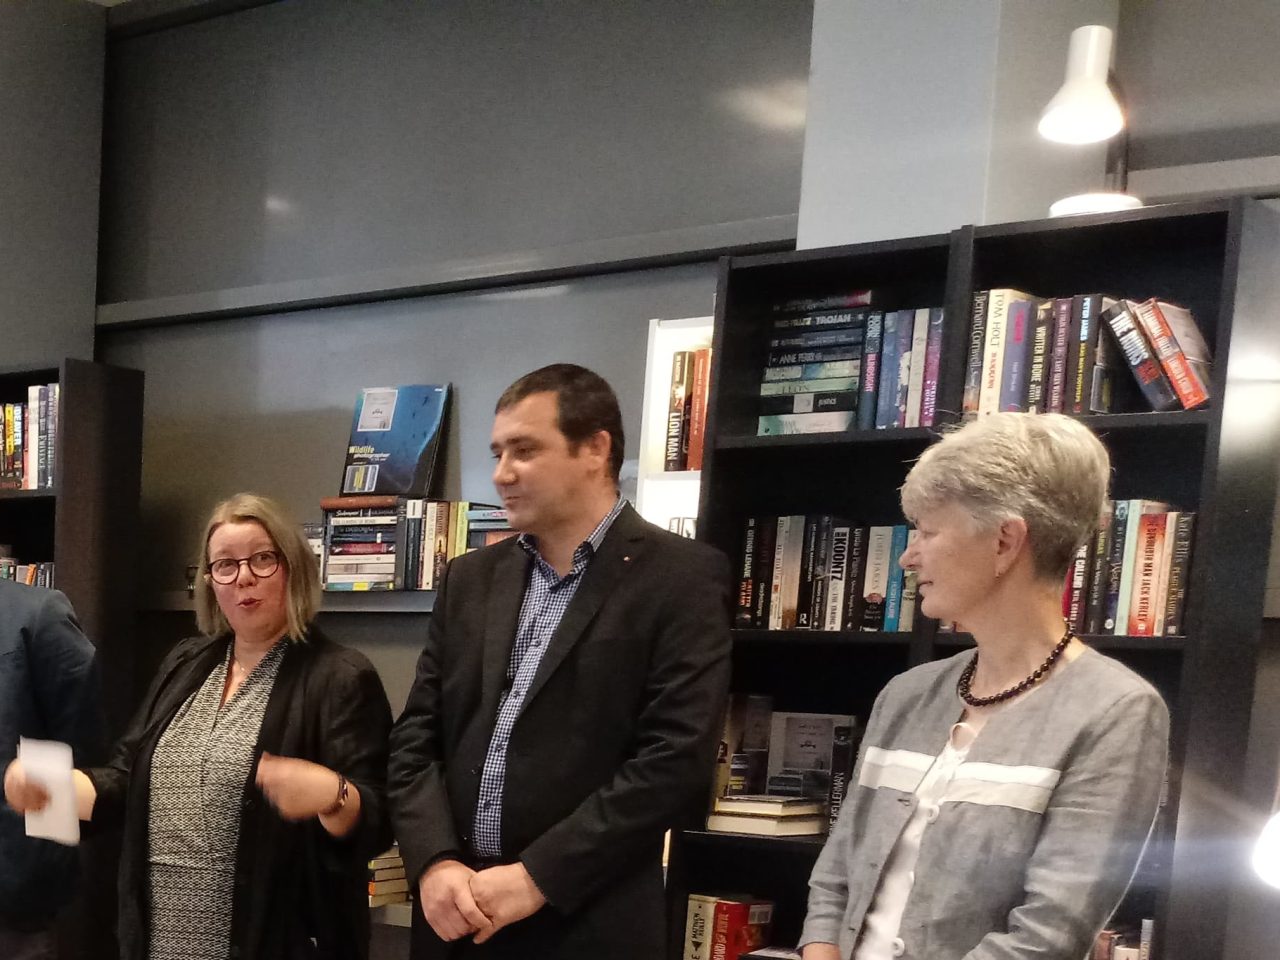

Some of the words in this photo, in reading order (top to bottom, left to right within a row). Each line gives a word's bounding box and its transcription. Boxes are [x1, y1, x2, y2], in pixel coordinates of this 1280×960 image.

[973, 296, 987, 330] Bernard
[993, 294, 1005, 318] TOM
[1081, 297, 1091, 319] PETER
[815, 313, 851, 325] TROJAN
[1080, 320, 1090, 341] JAMES
[990, 322, 1002, 348] HOLT
[1033, 326, 1046, 354] WRITTEN
[1109, 311, 1131, 337] THE
[1121, 331, 1149, 366] RUINS
[970, 331, 984, 366] Cornwell
[864, 353, 878, 393] BLINDSIGHT
[1030, 363, 1044, 382] BONE
[14, 406, 22, 445] DEAVER
[669, 412, 680, 436] LION
[666, 438, 679, 460] MAN
[853, 528, 863, 547] Lynda
[1178, 516, 1191, 537] Kate
[831, 538, 847, 581] KOONTZ
[853, 548, 862, 556] La
[743, 553, 753, 578] LEHANE
[1143, 563, 1154, 577] MAN
[1141, 579, 1152, 595] JACK
[831, 772, 844, 817] KELLERMAN
